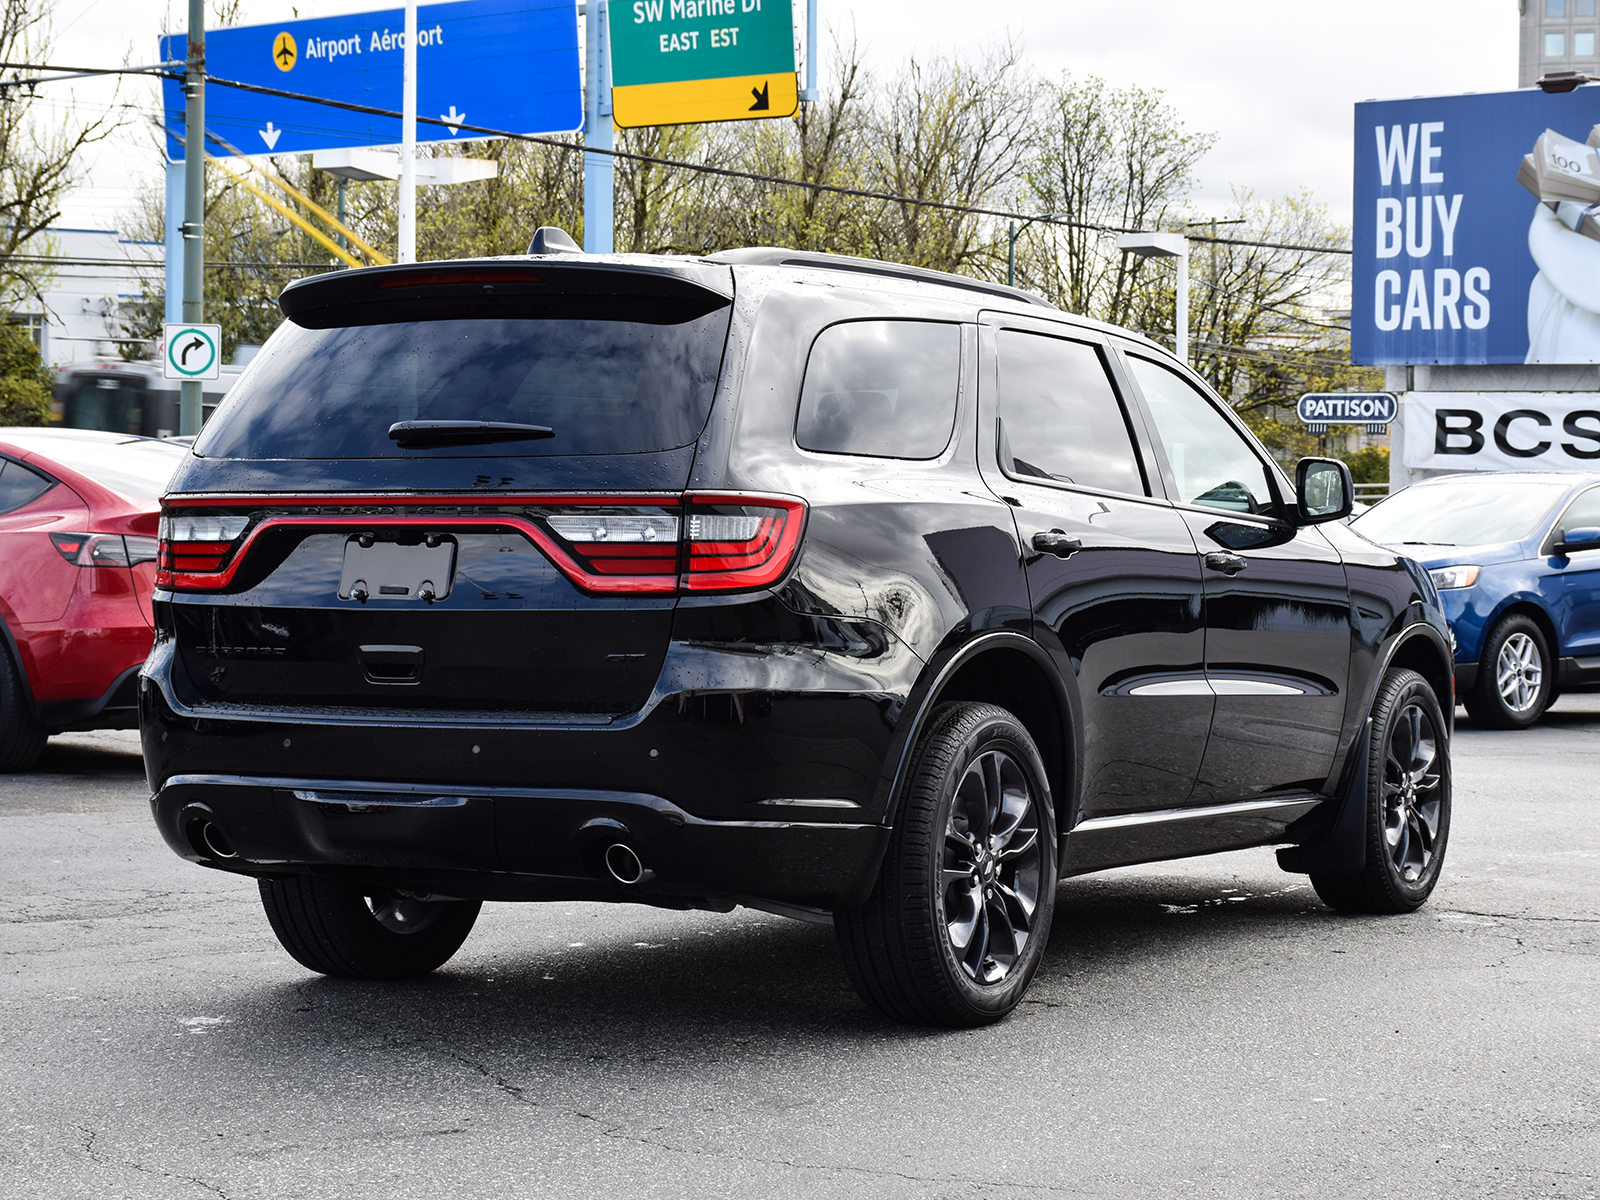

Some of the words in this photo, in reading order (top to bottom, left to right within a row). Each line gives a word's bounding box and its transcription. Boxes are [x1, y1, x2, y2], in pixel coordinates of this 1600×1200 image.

[633, 0, 664, 24] SW
[670, 0, 735, 20] Marine
[305, 34, 361, 63] Airport
[370, 25, 443, 52] Aéroort
[659, 31, 699, 53] EAST
[710, 27, 739, 48] EST
[1375, 121, 1444, 186] WE
[1551, 153, 1581, 173] 100
[1376, 194, 1464, 259] BUY
[1374, 266, 1491, 332] CARS
[1305, 399, 1389, 417] PATTISON
